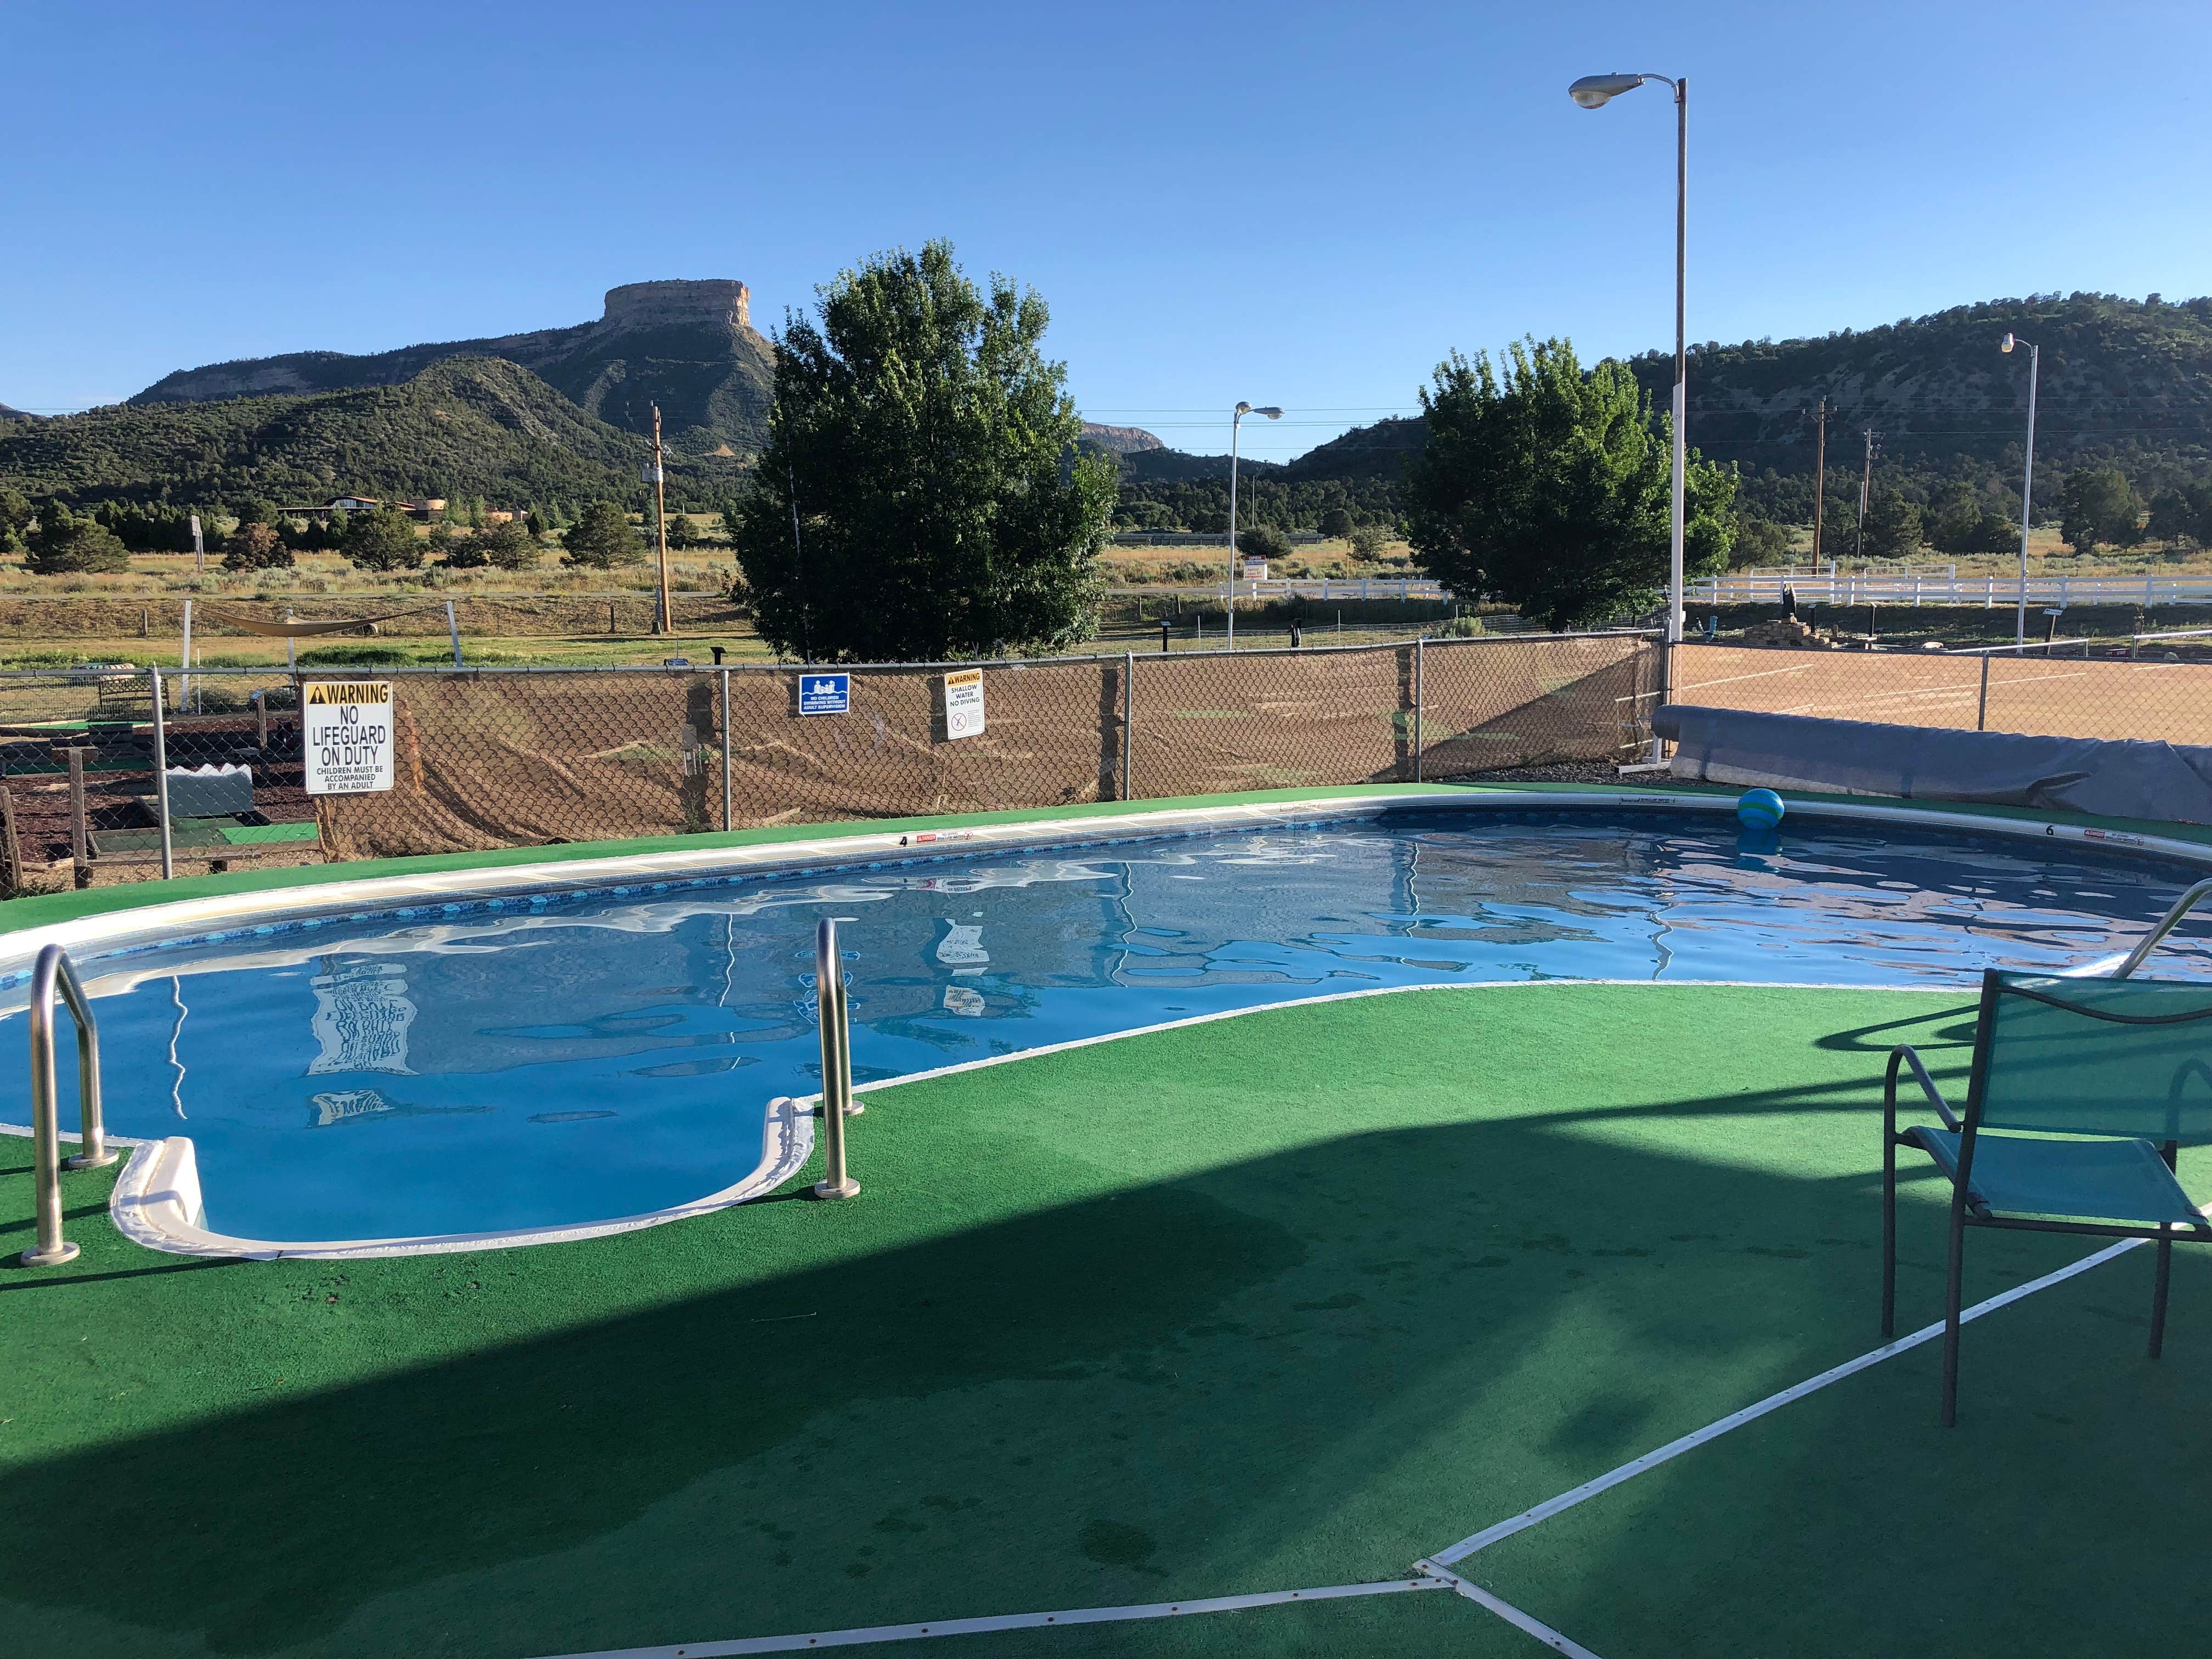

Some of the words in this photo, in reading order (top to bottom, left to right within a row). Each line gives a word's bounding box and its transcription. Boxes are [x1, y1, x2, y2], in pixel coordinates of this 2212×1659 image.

[955, 673, 980, 683] WARNING
[326, 684, 388, 703] WARNING
[951, 684, 978, 693] SHALLOW
[961, 697, 980, 705] DIVING
[340, 706, 359, 725] NO
[313, 725, 386, 746] LIFEGUARD
[321, 747, 340, 766] ON
[345, 746, 379, 765] DUTY
[325, 774, 376, 782] ACCOMPANIED
[2046, 825, 2054, 836] 6
[900, 836, 908, 847] 4
